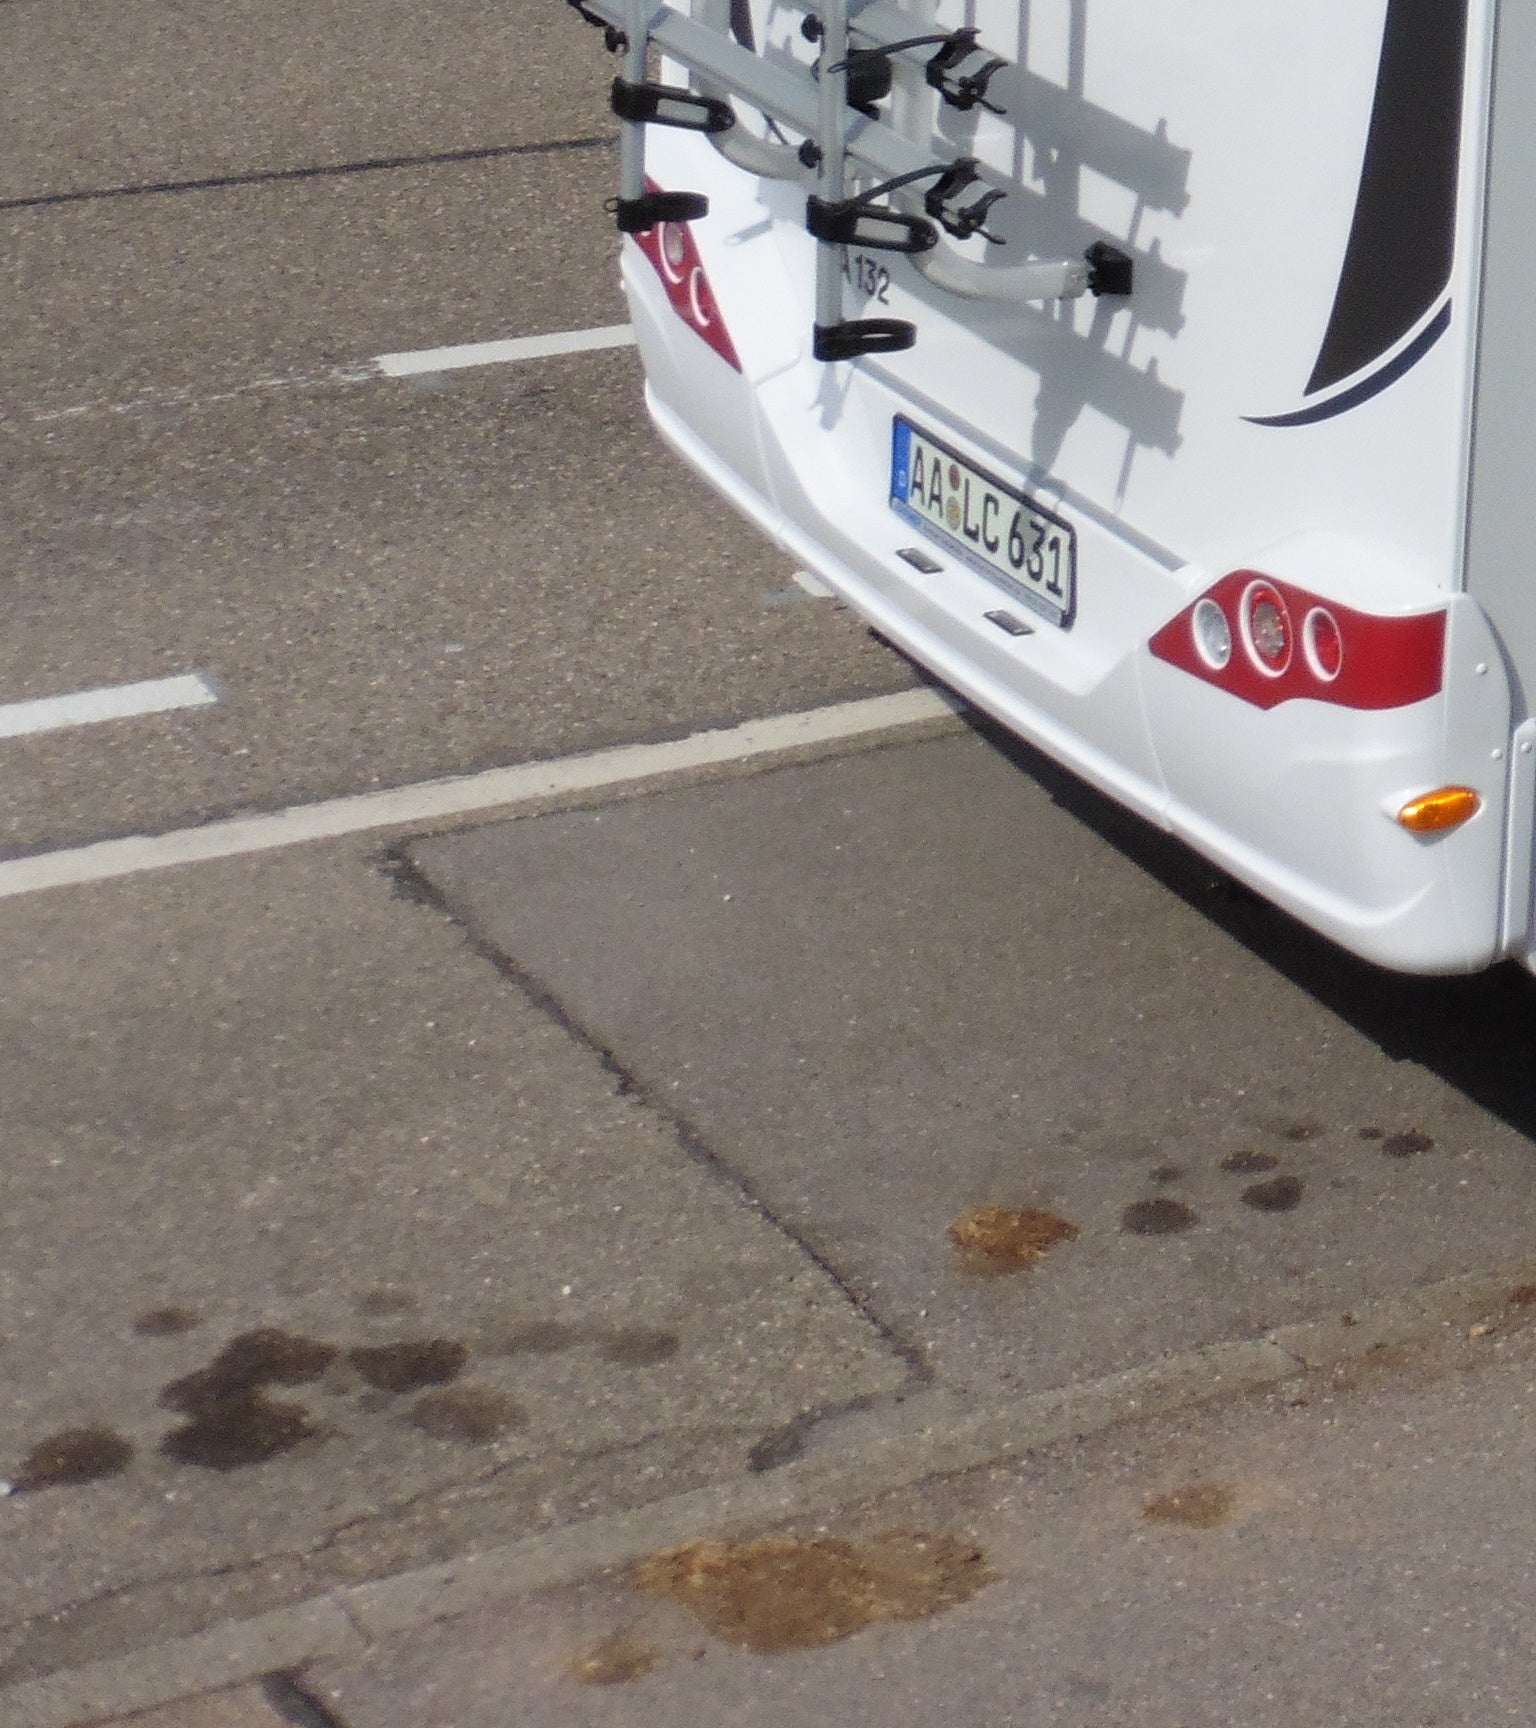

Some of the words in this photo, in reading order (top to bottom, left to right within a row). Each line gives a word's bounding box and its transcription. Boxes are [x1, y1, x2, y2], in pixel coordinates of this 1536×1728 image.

[855, 254, 890, 306] 132
[910, 446, 944, 519] AA
[962, 478, 1000, 554] LC
[1007, 511, 1063, 599] 631
